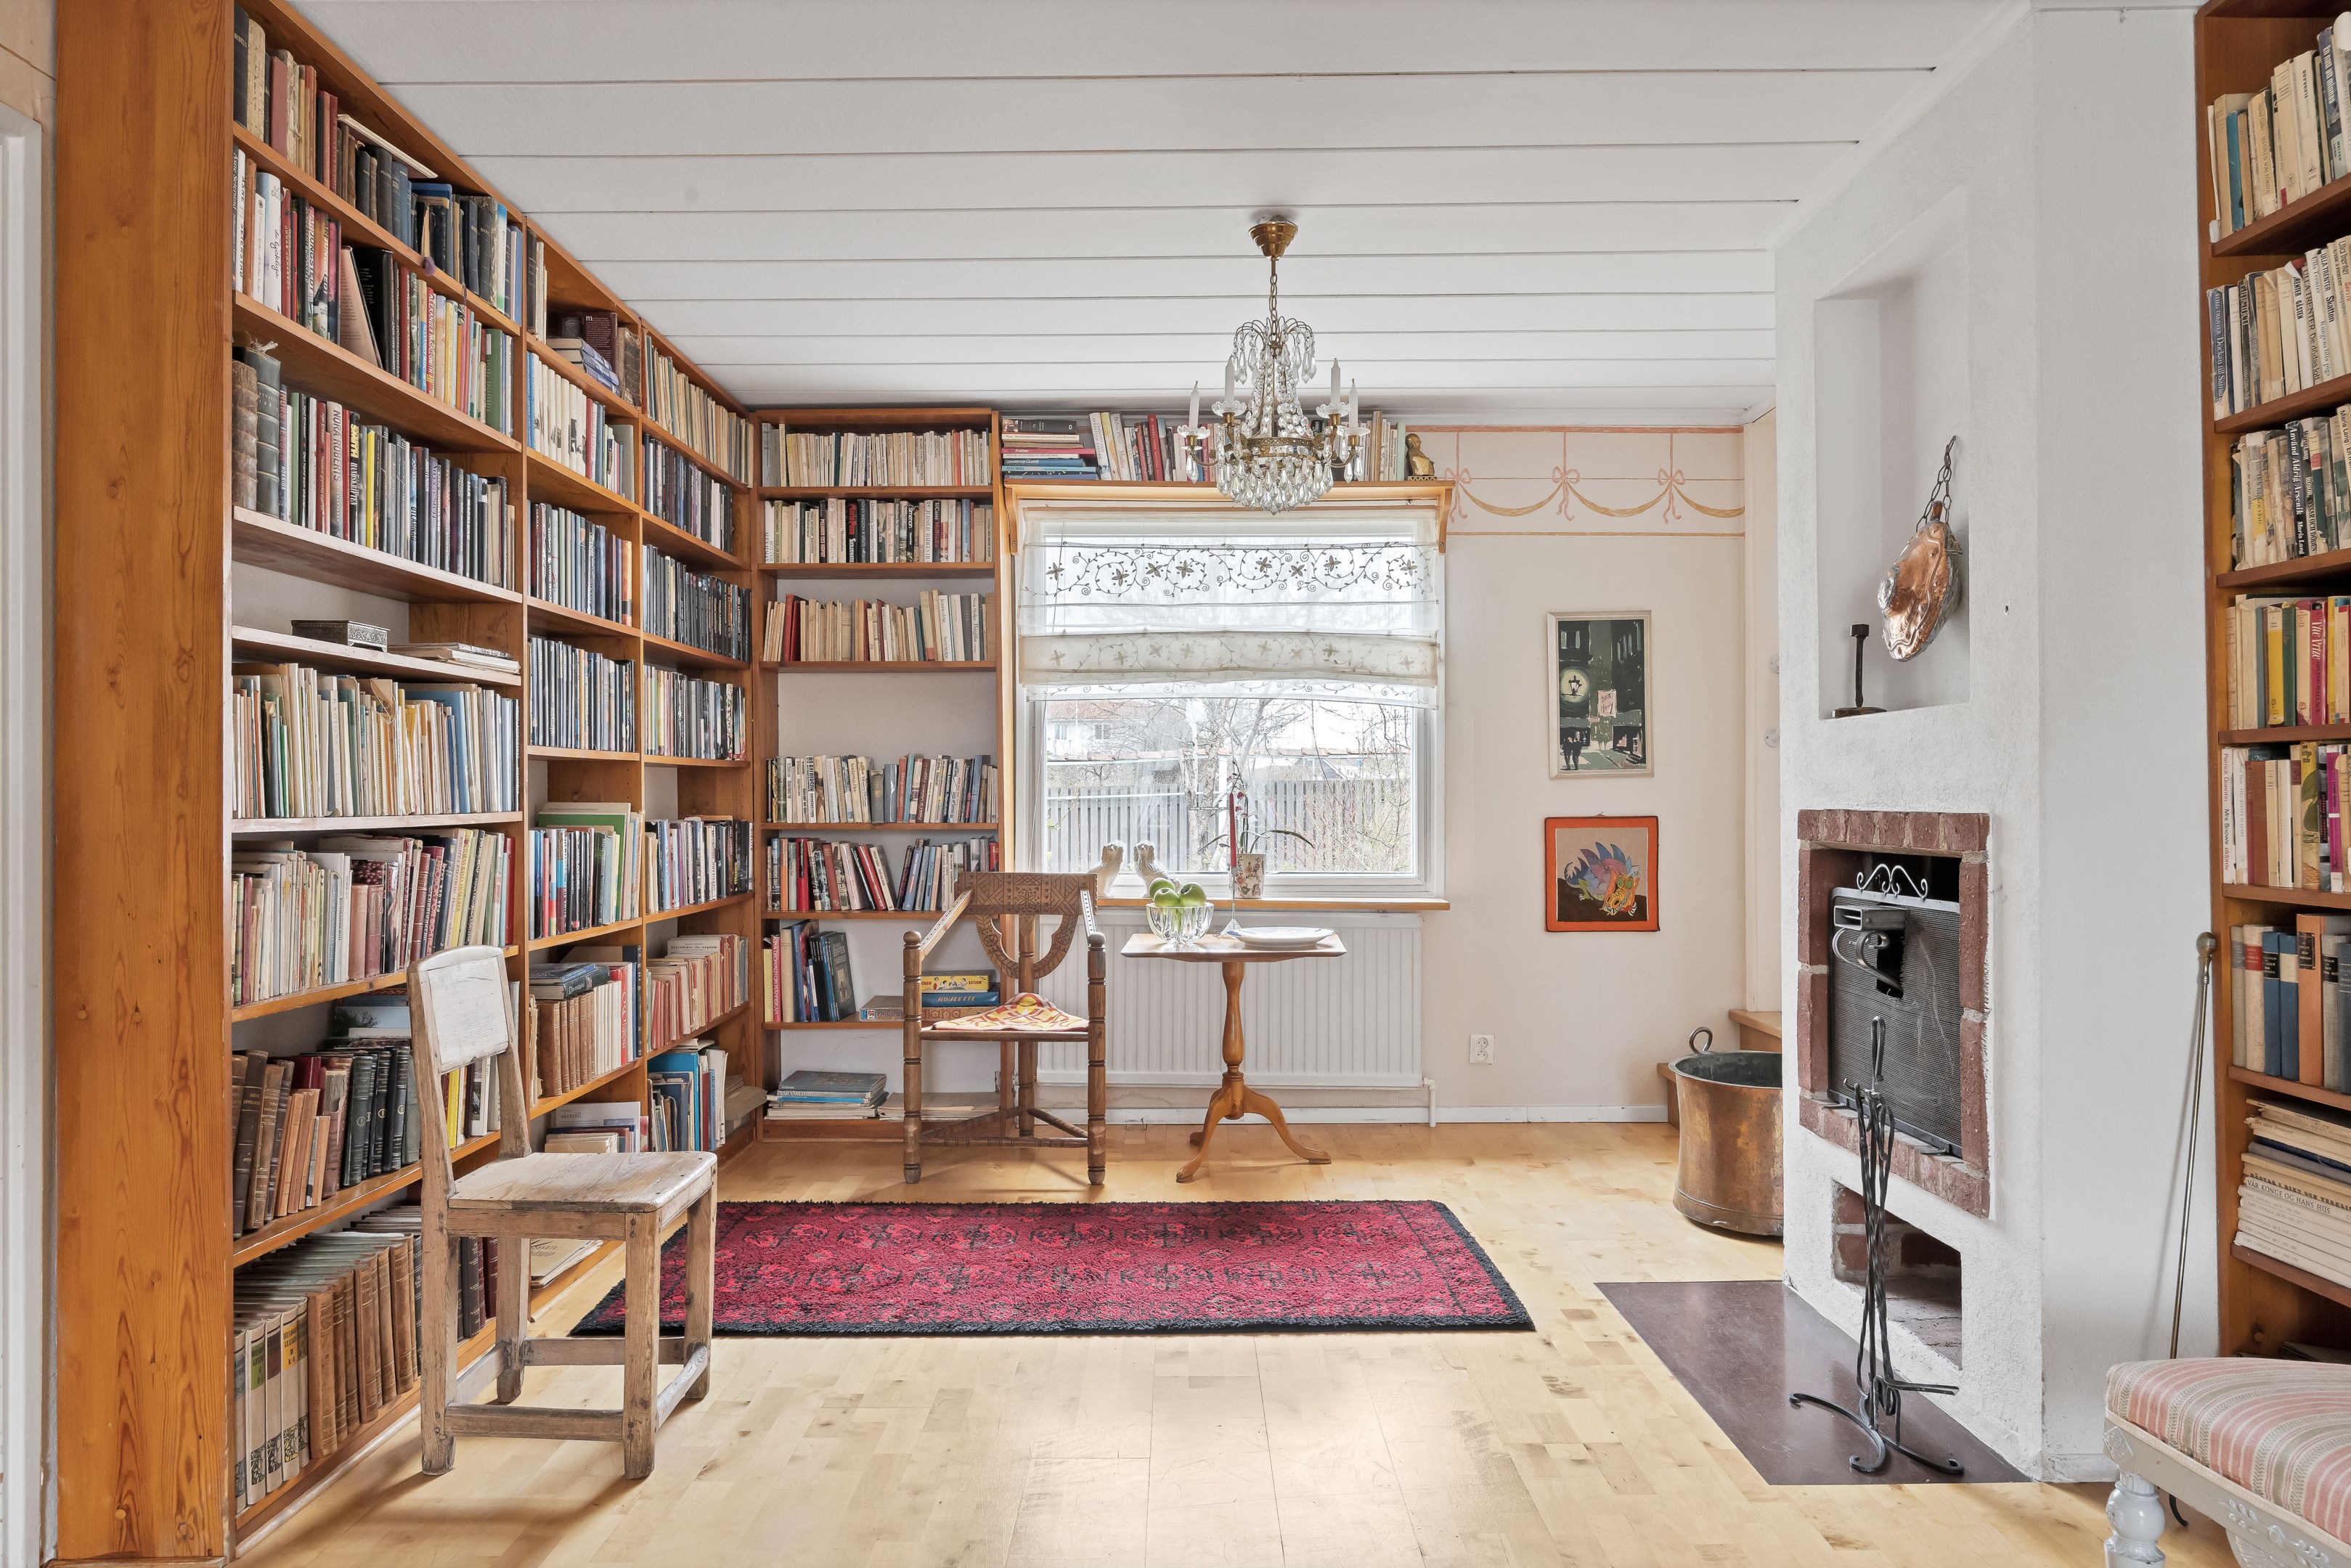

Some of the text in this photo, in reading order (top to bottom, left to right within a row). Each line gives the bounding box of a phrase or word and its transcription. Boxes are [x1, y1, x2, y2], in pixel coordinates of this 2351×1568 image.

[2338, 240, 2347, 254] Ulla
[2339, 254, 2350, 276] Trenter
[2302, 269, 2311, 292] ULLA
[2322, 266, 2331, 292] TRENTER
[2295, 300, 2305, 321] GÄSTEN
[2305, 292, 2315, 331] TRENTER
[2326, 295, 2336, 324] Skatten
[2309, 332, 2317, 345] De
[2319, 320, 2328, 349] Kungens
[2289, 427, 2299, 457] Använd
[2291, 457, 2301, 483] Aldrig
[2294, 484, 2304, 515] Arsenik
[2312, 619, 2323, 638] The
[2312, 638, 2323, 661] Prize
[404, 886, 410, 902] OM
[2247, 1179, 2260, 1190] VÅR
[2261, 1184, 2283, 1199] KONGE
[2284, 1193, 2294, 1202] OG
[2296, 1196, 2314, 1209] HANS
[2317, 1203, 2331, 1214] HUS
